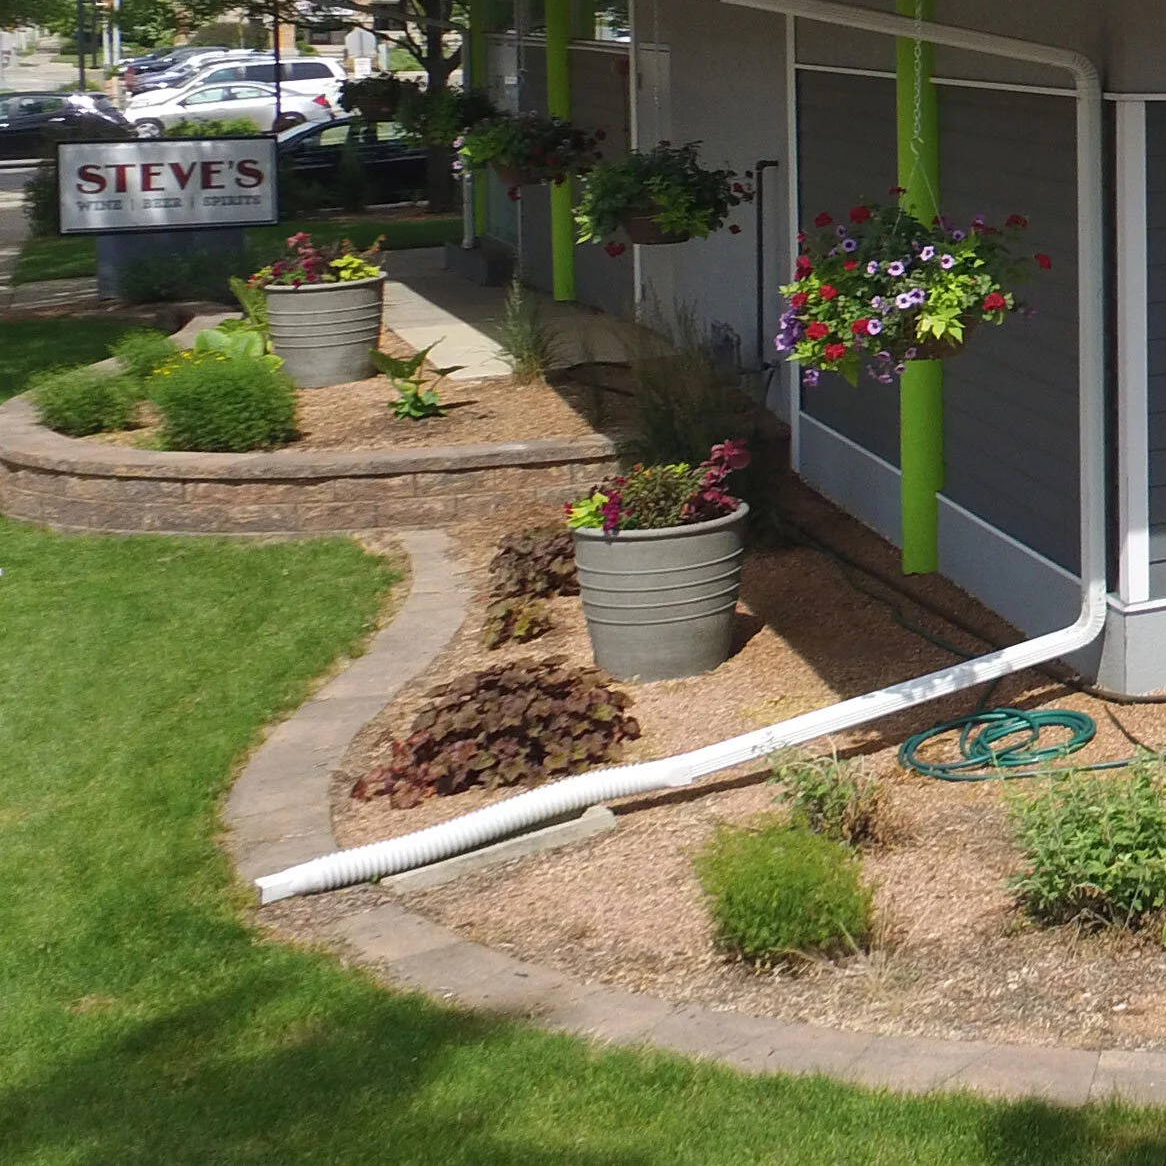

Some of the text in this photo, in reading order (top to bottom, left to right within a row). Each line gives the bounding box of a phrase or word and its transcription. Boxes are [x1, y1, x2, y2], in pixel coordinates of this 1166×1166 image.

[76, 159, 265, 195] STEVE'S
[76, 195, 262, 212] WINE BEER SPIRITS
